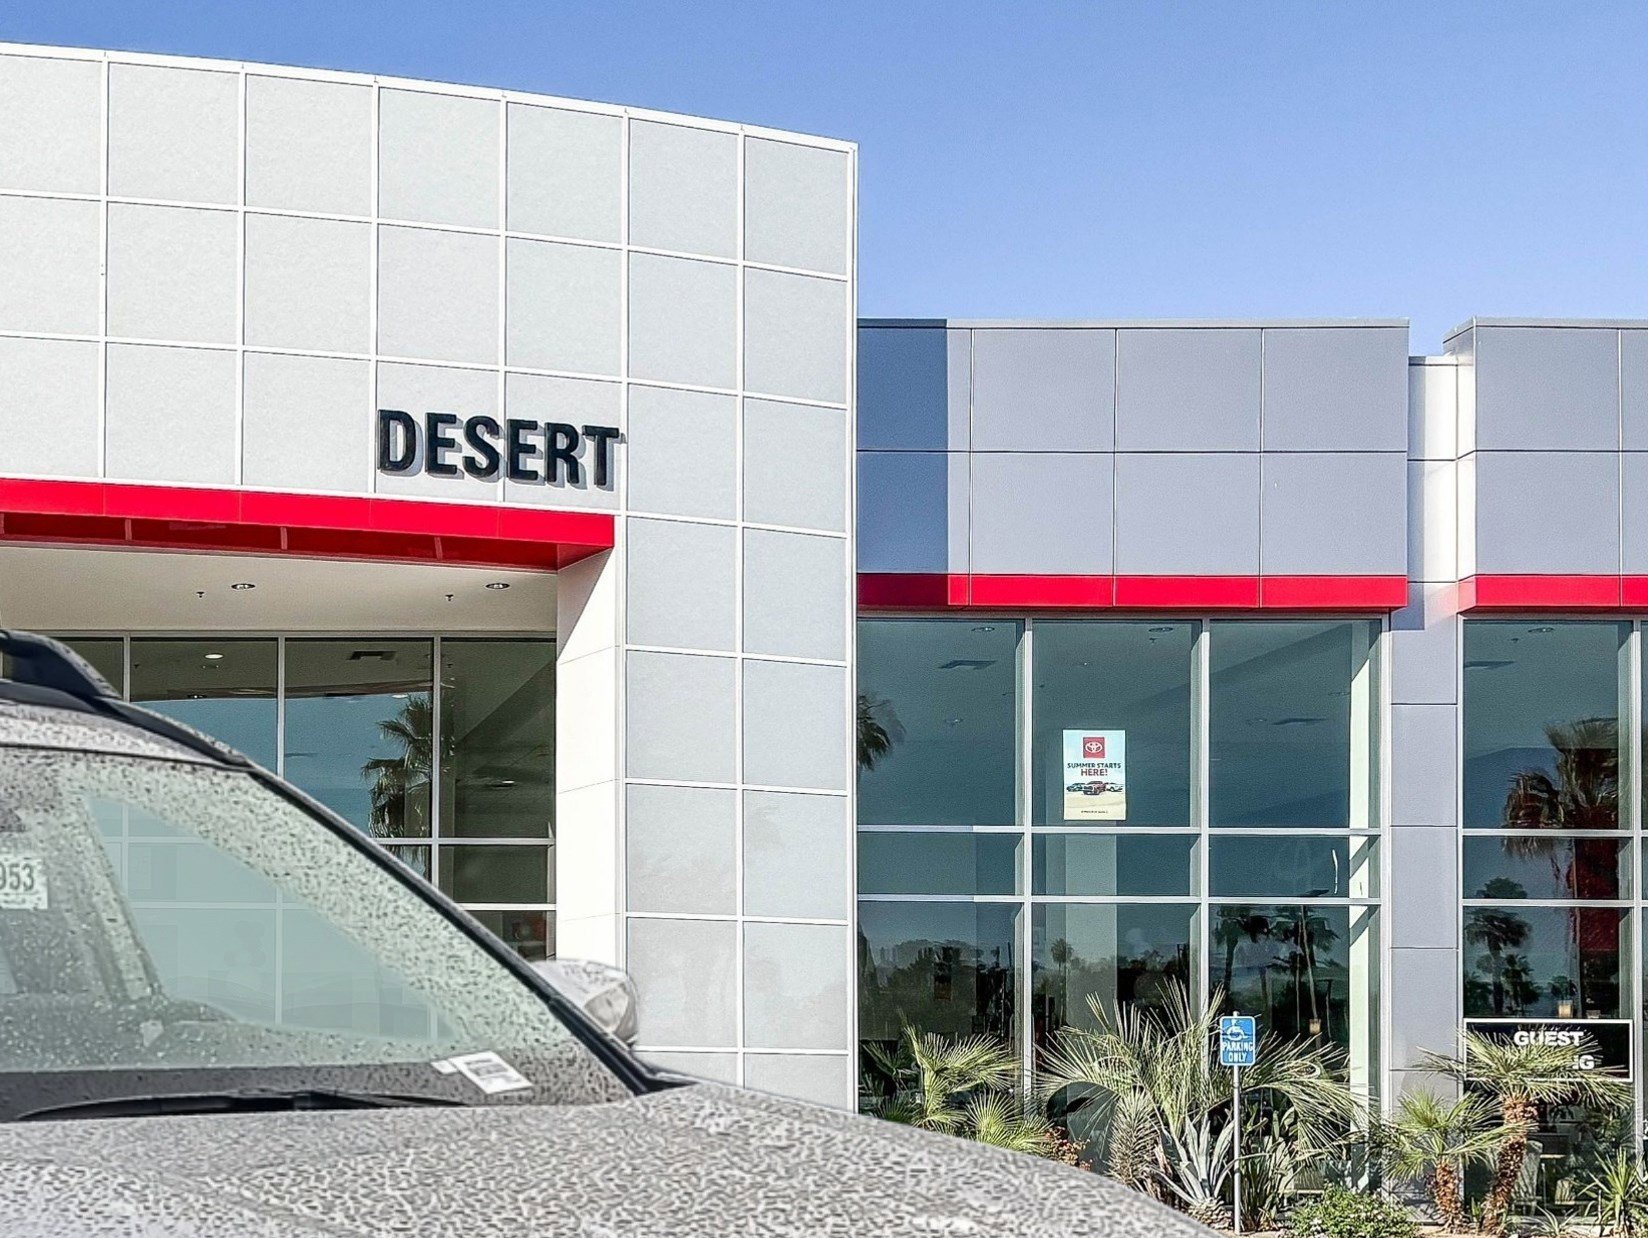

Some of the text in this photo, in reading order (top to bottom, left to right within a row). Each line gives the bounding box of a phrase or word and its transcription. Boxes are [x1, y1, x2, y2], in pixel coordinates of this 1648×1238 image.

[376, 409, 621, 487] DESERT
[1080, 768, 1108, 777] HERE!
[1513, 1030, 1585, 1047] GUEST
[1222, 1041, 1254, 1052] PARKING
[1228, 1052, 1248, 1062] ONLY
